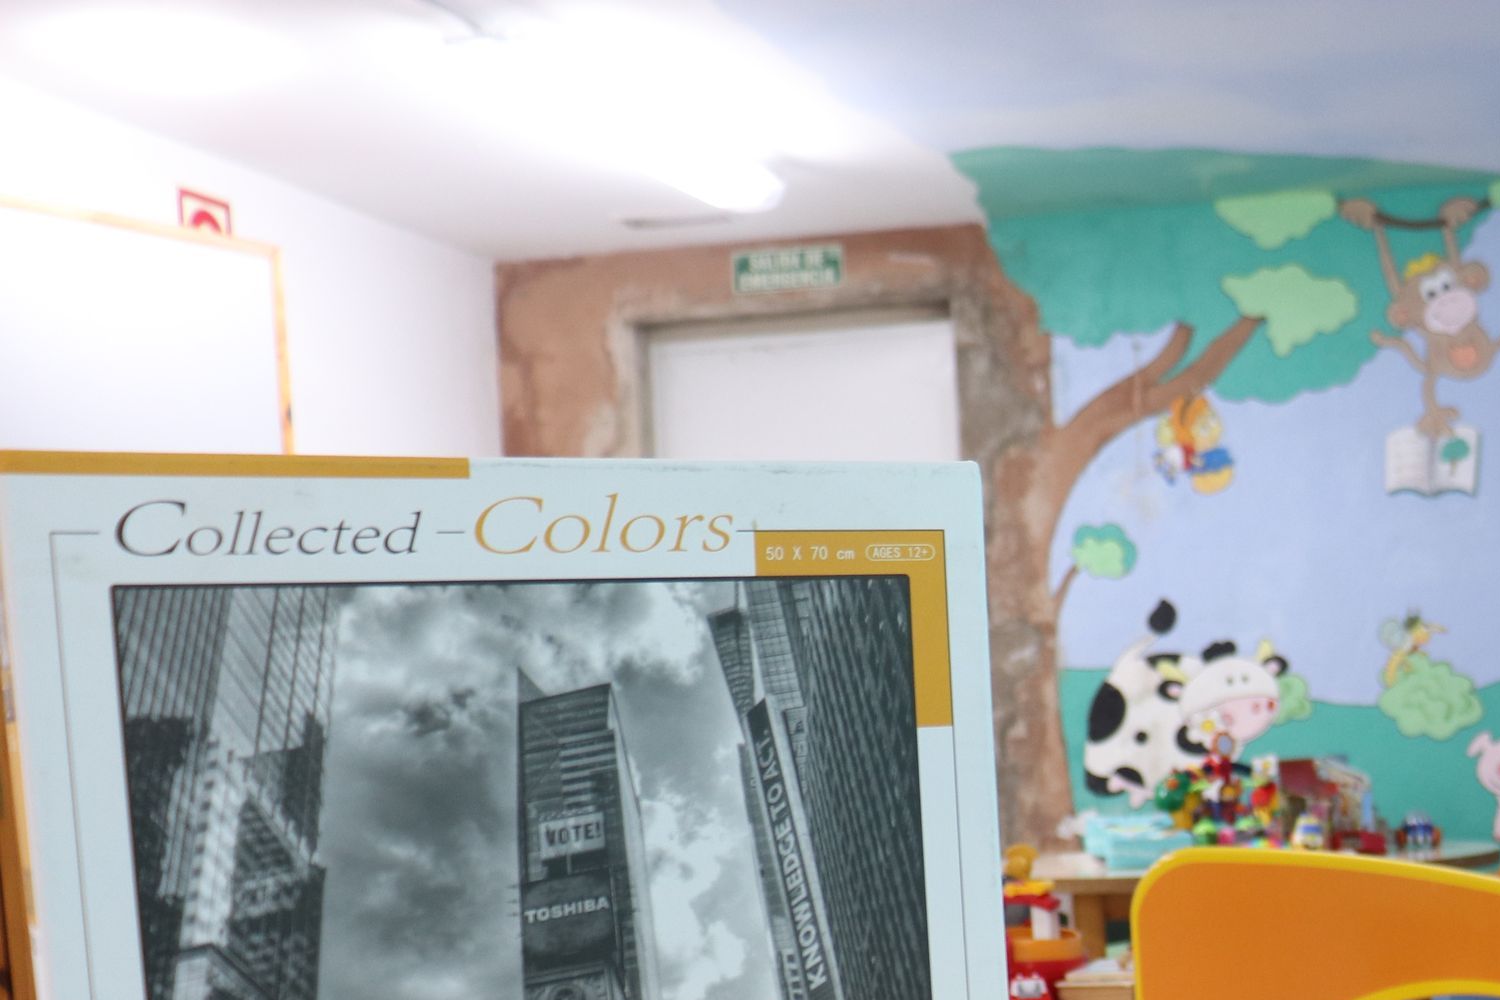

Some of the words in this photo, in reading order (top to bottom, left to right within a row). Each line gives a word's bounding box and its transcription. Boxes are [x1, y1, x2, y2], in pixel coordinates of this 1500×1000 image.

[115, 499, 421, 557] Collected
[474, 493, 734, 554] Colors
[765, 546, 784, 561] 50
[810, 546, 828, 560] 70
[836, 549, 855, 560] cm
[873, 547, 901, 559] AGES
[908, 547, 928, 559] 12+
[766, 783, 788, 817] TO
[546, 822, 601, 847] VOTE!
[524, 897, 609, 924] TOSHIBA
[775, 817, 827, 991] KNOWLEDGE
